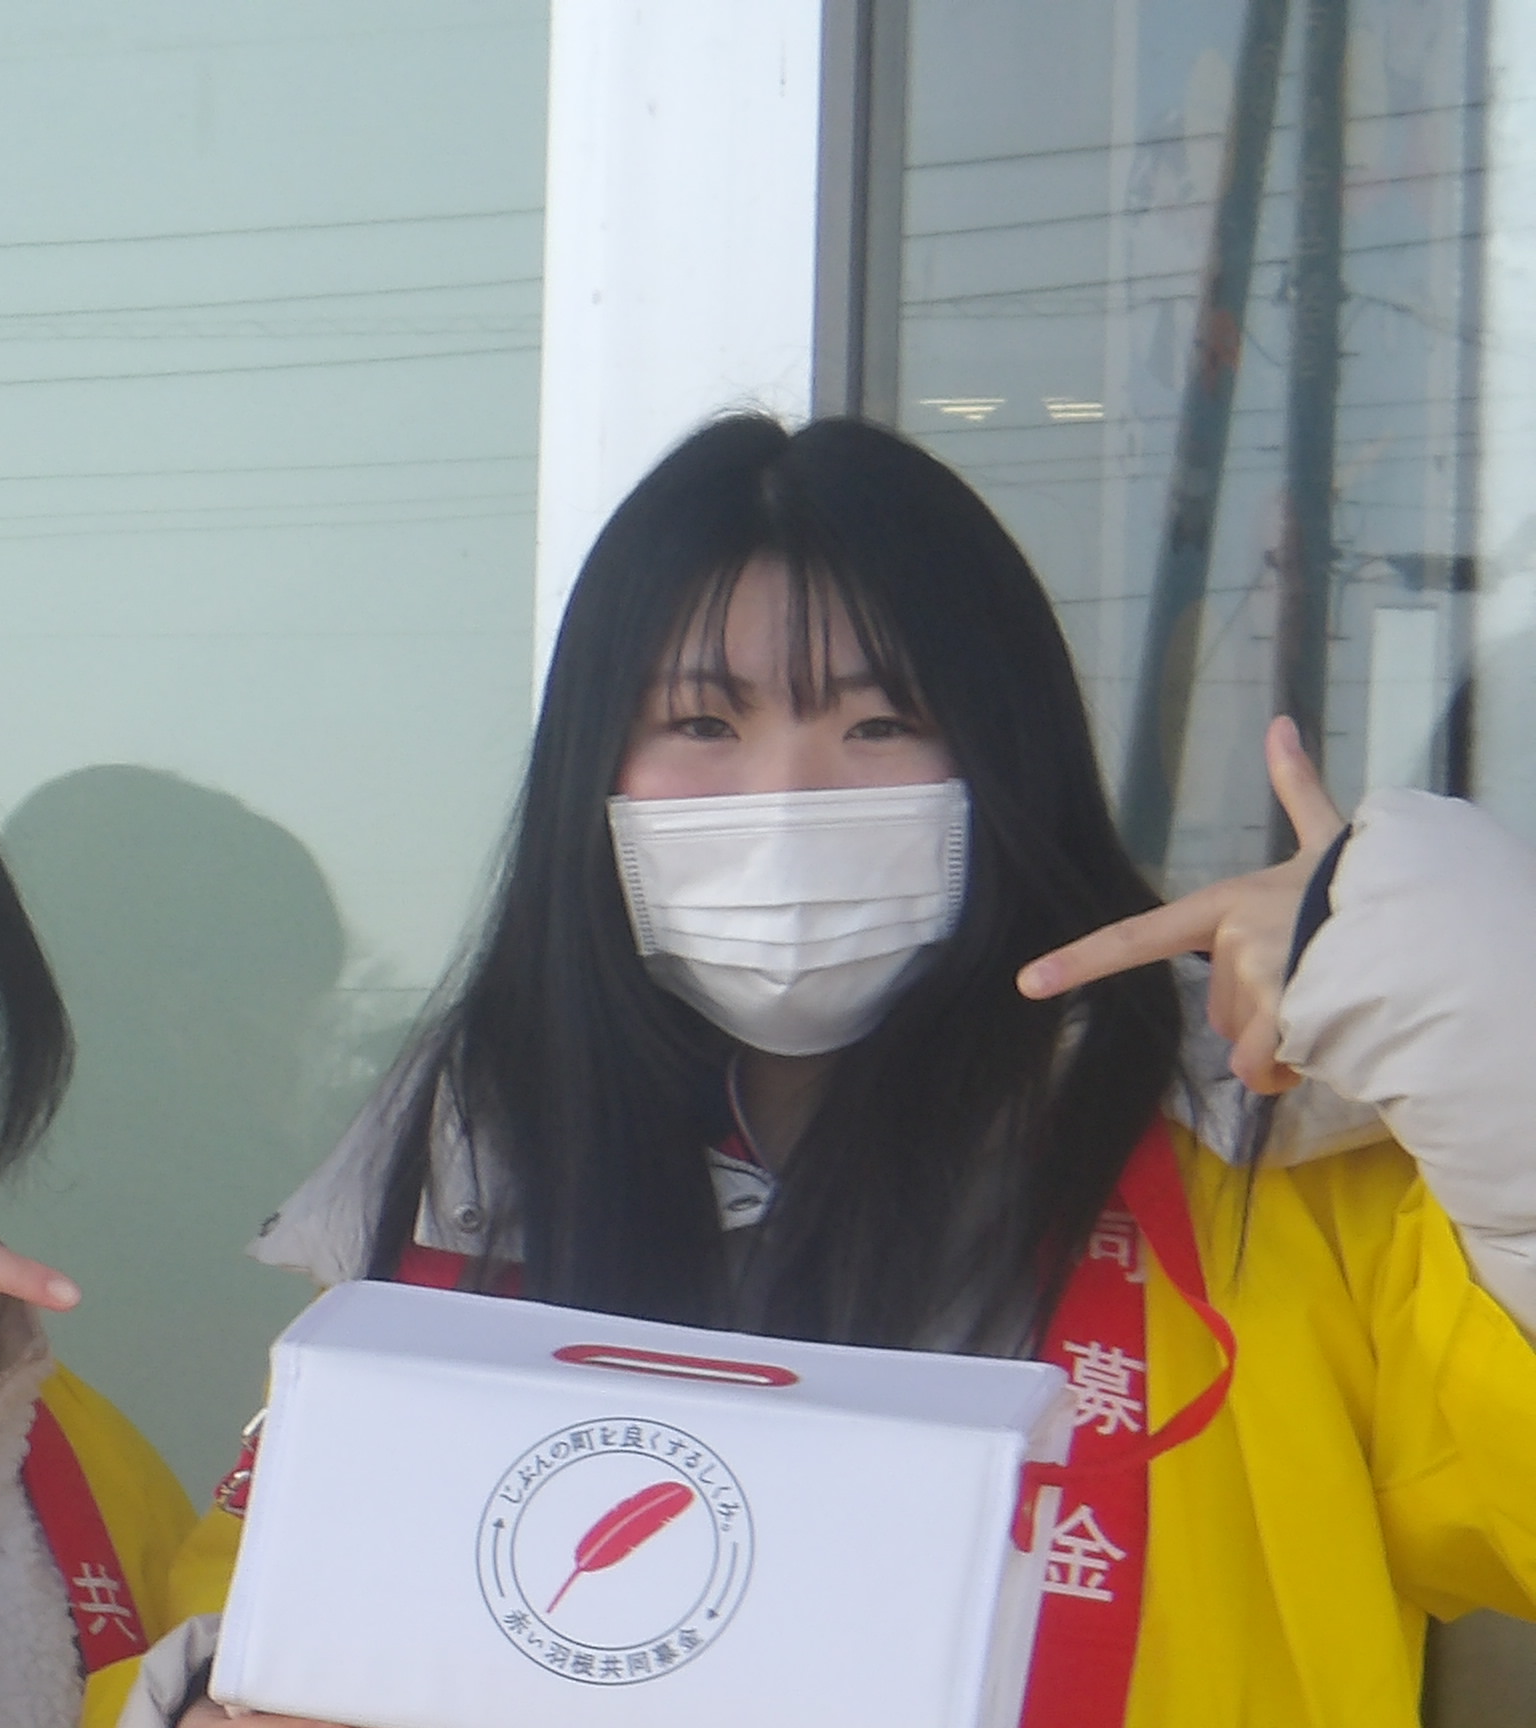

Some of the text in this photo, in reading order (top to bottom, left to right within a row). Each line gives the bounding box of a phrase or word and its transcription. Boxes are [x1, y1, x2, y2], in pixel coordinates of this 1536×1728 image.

[503, 1607, 706, 1679] 赤い羽根共同募金
